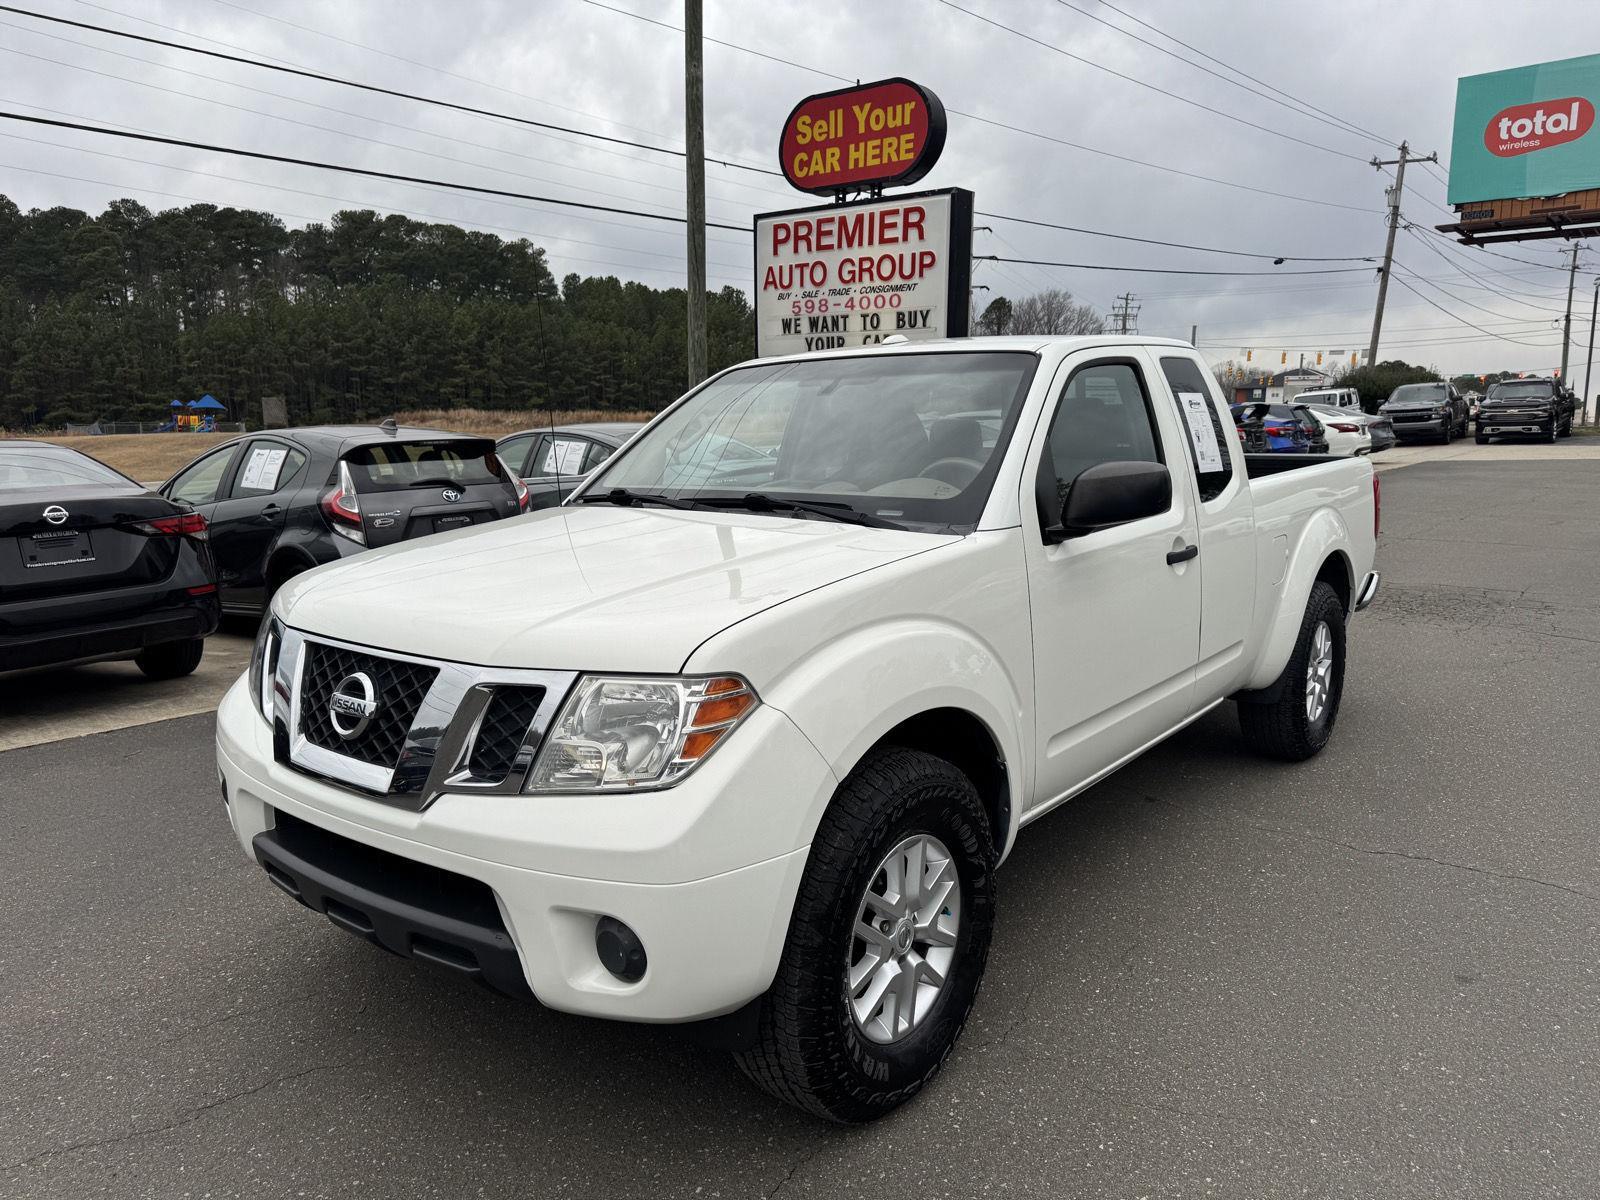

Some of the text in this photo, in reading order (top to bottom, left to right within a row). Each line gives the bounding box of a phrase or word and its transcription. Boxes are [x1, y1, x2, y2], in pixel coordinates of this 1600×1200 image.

[796, 101, 916, 145] Sell Your
[1498, 102, 1580, 140] total
[793, 133, 915, 178] CAR HERE
[1499, 139, 1541, 151] wireless
[773, 206, 926, 257] PREMIER
[763, 250, 937, 291] AUTO GROUP
[777, 283, 918, 301] BUY SALE TRADE CONSIGNMENT
[791, 293, 902, 315] 598-4000
[782, 309, 931, 334] WE WANT TO BUY
[862, 333, 890, 346] CA
[333, 695, 367, 715] NISSAN
